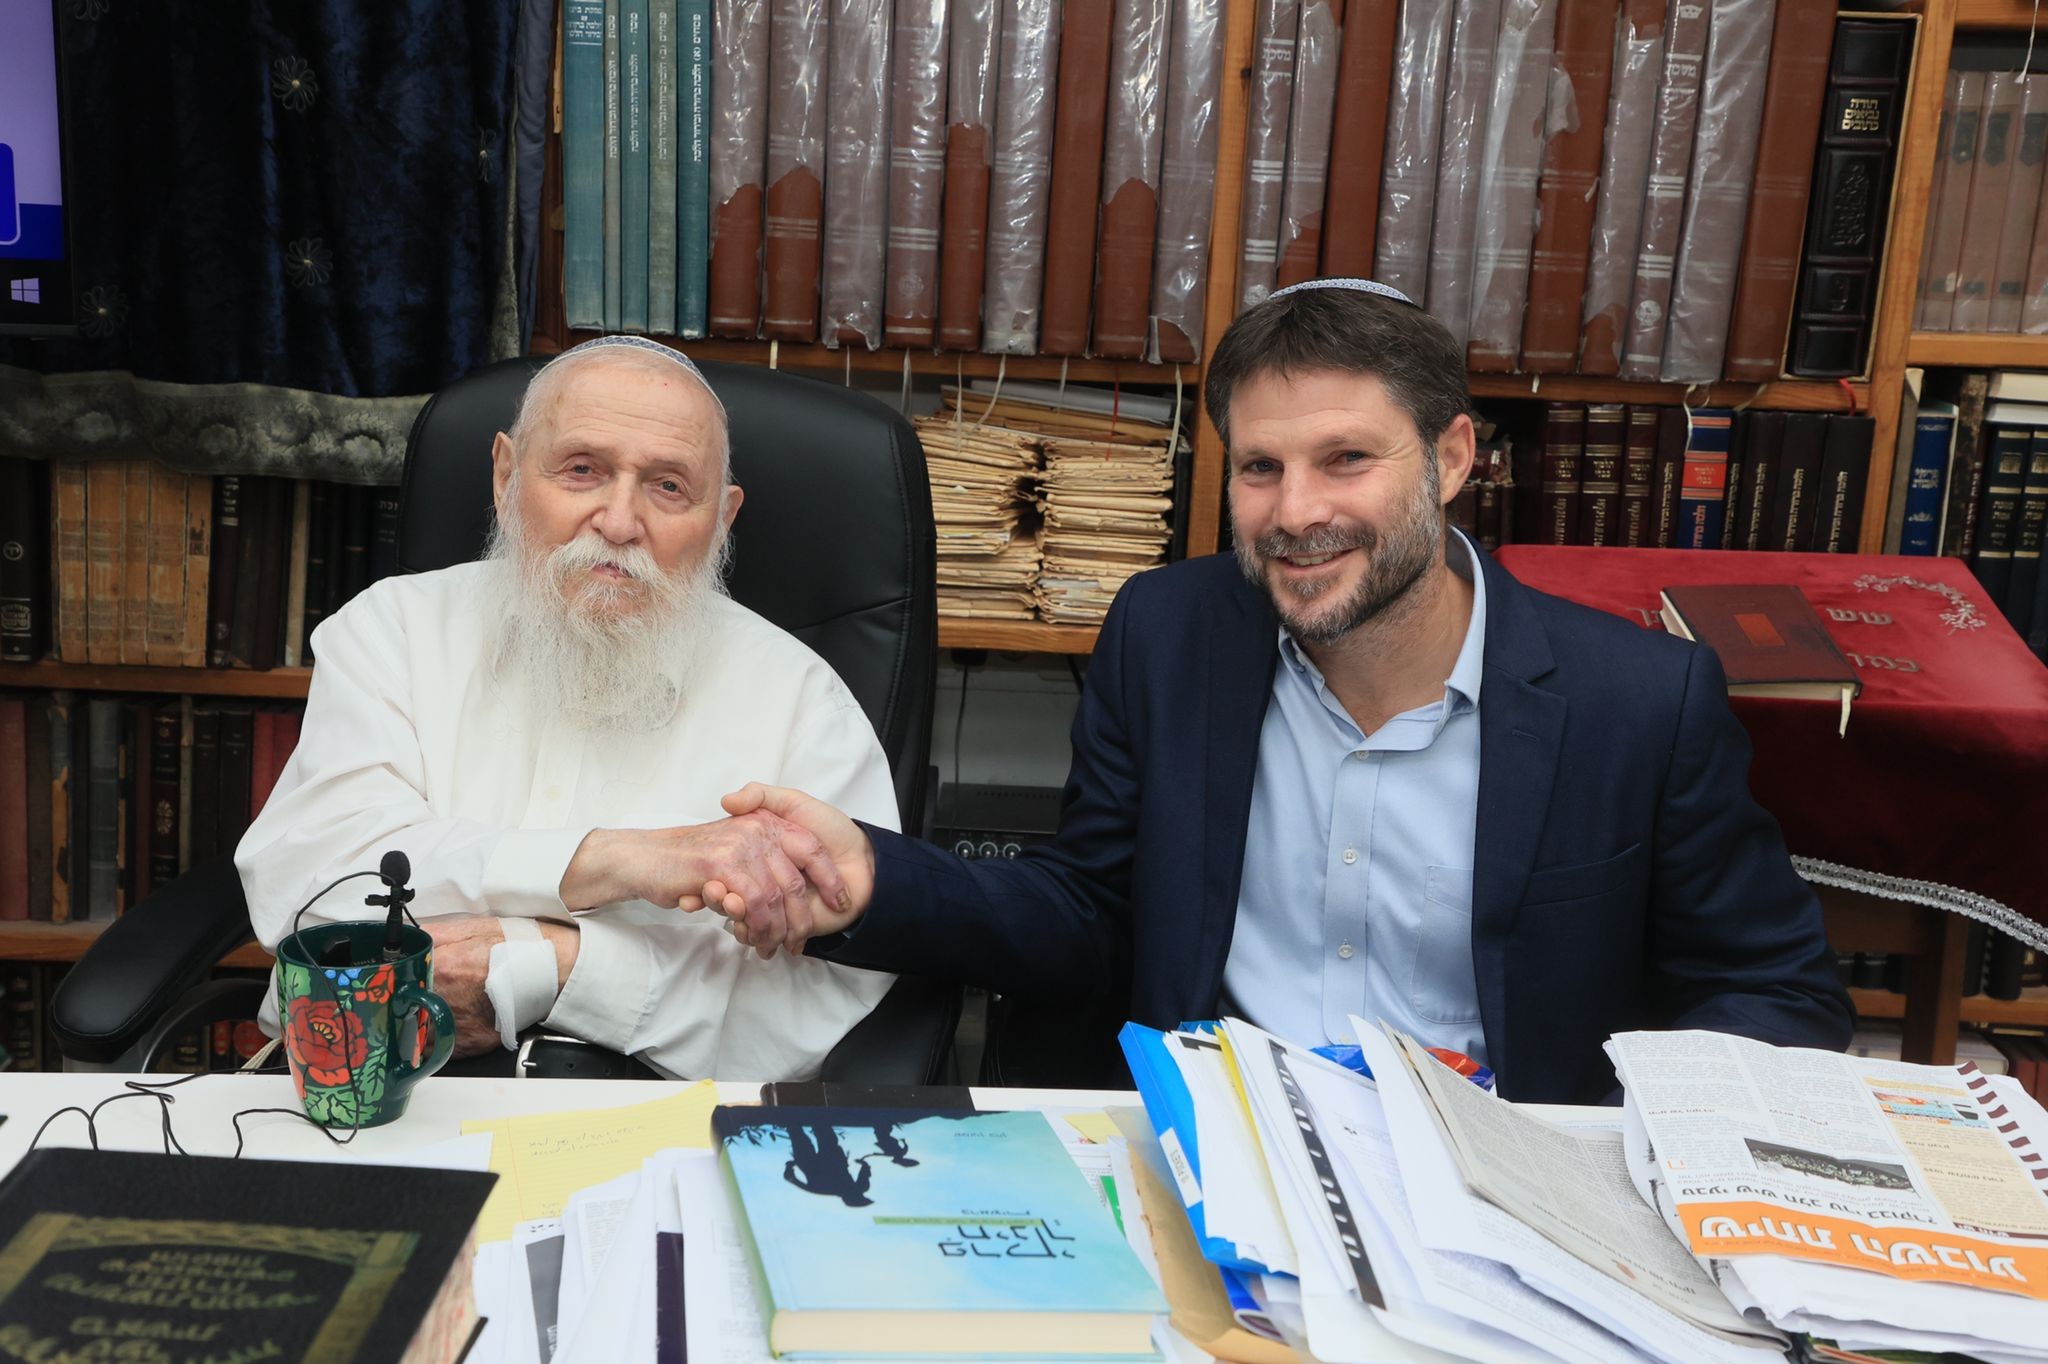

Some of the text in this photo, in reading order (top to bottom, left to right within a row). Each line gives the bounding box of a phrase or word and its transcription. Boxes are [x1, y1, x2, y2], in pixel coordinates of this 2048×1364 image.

[692, 14, 702, 44] פסחים
[628, 54, 638, 77] הלכה
[1262, 48, 1291, 61] מסכת
[607, 60, 616, 82] הלכה
[658, 62, 667, 84] הלכה
[691, 64, 701, 86] הלכה
[1664, 63, 1696, 78] מסכת
[608, 83, 616, 109] ברורה
[630, 77, 639, 103] ברורה
[658, 85, 667, 112] ברורה
[692, 87, 702, 113] ברורה
[1844, 109, 1880, 119] נביאים
[1850, 98, 1879, 109] תורה
[608, 110, 617, 134] ובירור
[630, 104, 639, 128] ובירור
[692, 113, 702, 138] ובירור
[1841, 119, 1879, 130] כתובים
[608, 136, 617, 158] הלכה
[630, 130, 639, 152] הלכה
[658, 137, 667, 160] הלכה
[691, 139, 702, 162] הלכה
[1825, 607, 1893, 625] שש
[1681, 1186, 1727, 1197] טבעי
[1736, 1185, 1776, 1199] שיש
[1784, 1194, 1821, 1210] חלב
[1830, 1202, 1861, 1216] טרי
[938, 1227, 1076, 1259] פרקי
[1700, 1215, 2028, 1283] שיחת השבוע
